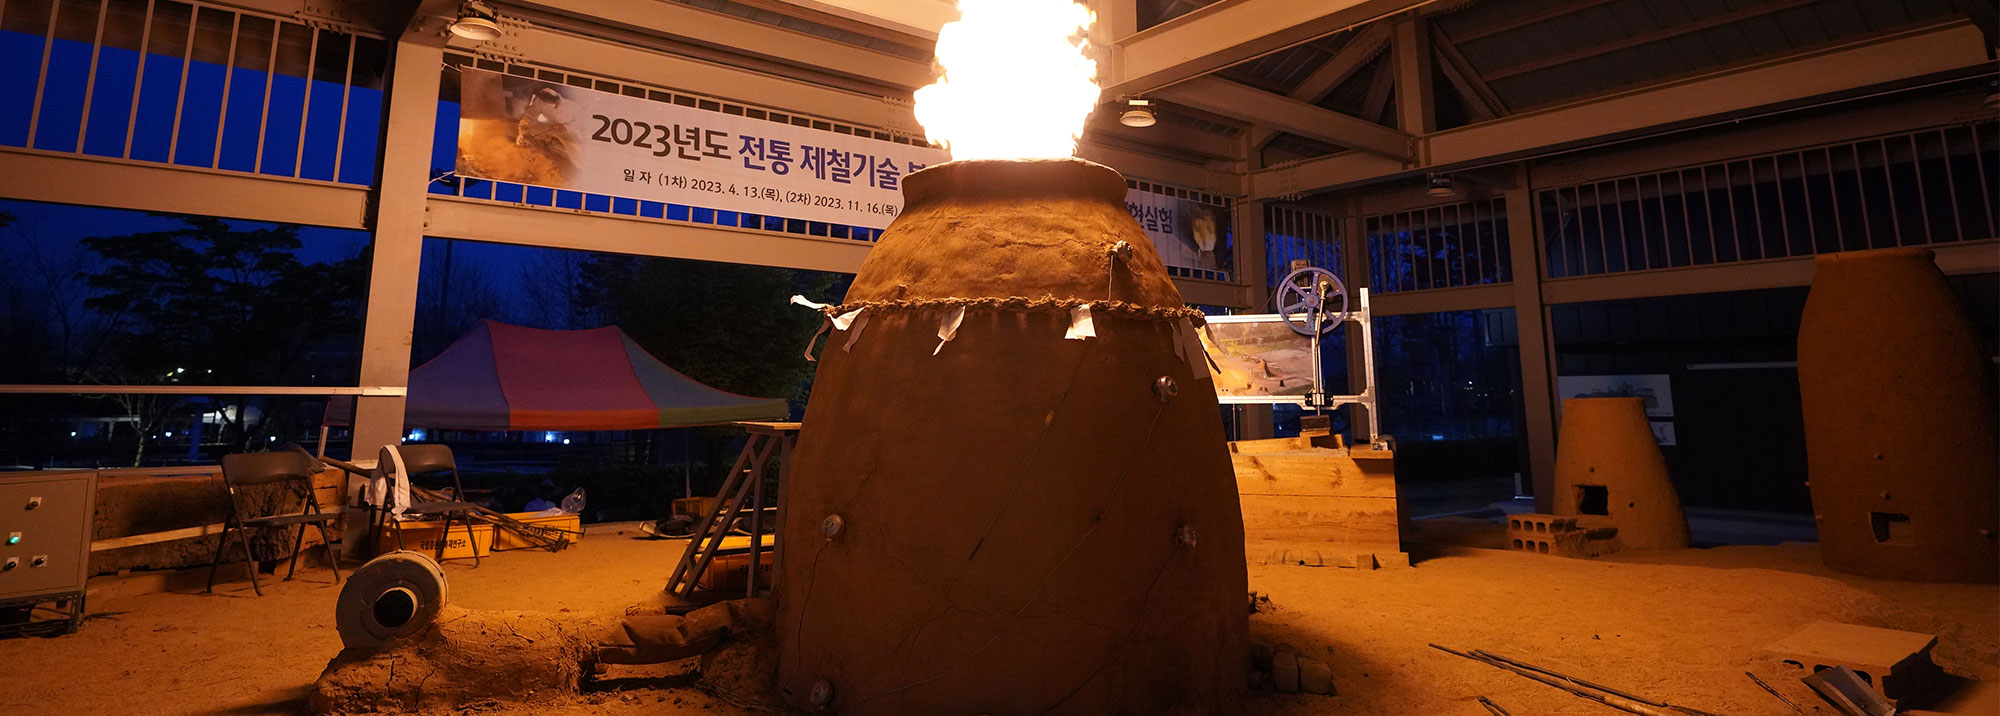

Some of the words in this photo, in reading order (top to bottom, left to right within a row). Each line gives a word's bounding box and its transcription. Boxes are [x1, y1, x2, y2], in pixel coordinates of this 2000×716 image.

[591, 114, 732, 162] 2023년도
[738, 134, 794, 176] 전통
[800, 144, 901, 191] 제철기술
[658, 173, 688, 190] (1차)
[691, 178, 725, 194] 2023.
[728, 184, 740, 196] 4.
[743, 186, 783, 203] 13.(목),
[786, 190, 812, 206] (2차)
[814, 195, 844, 210] 2023.
[849, 200, 863, 212] 11.
[866, 202, 898, 217] 16.(목)
